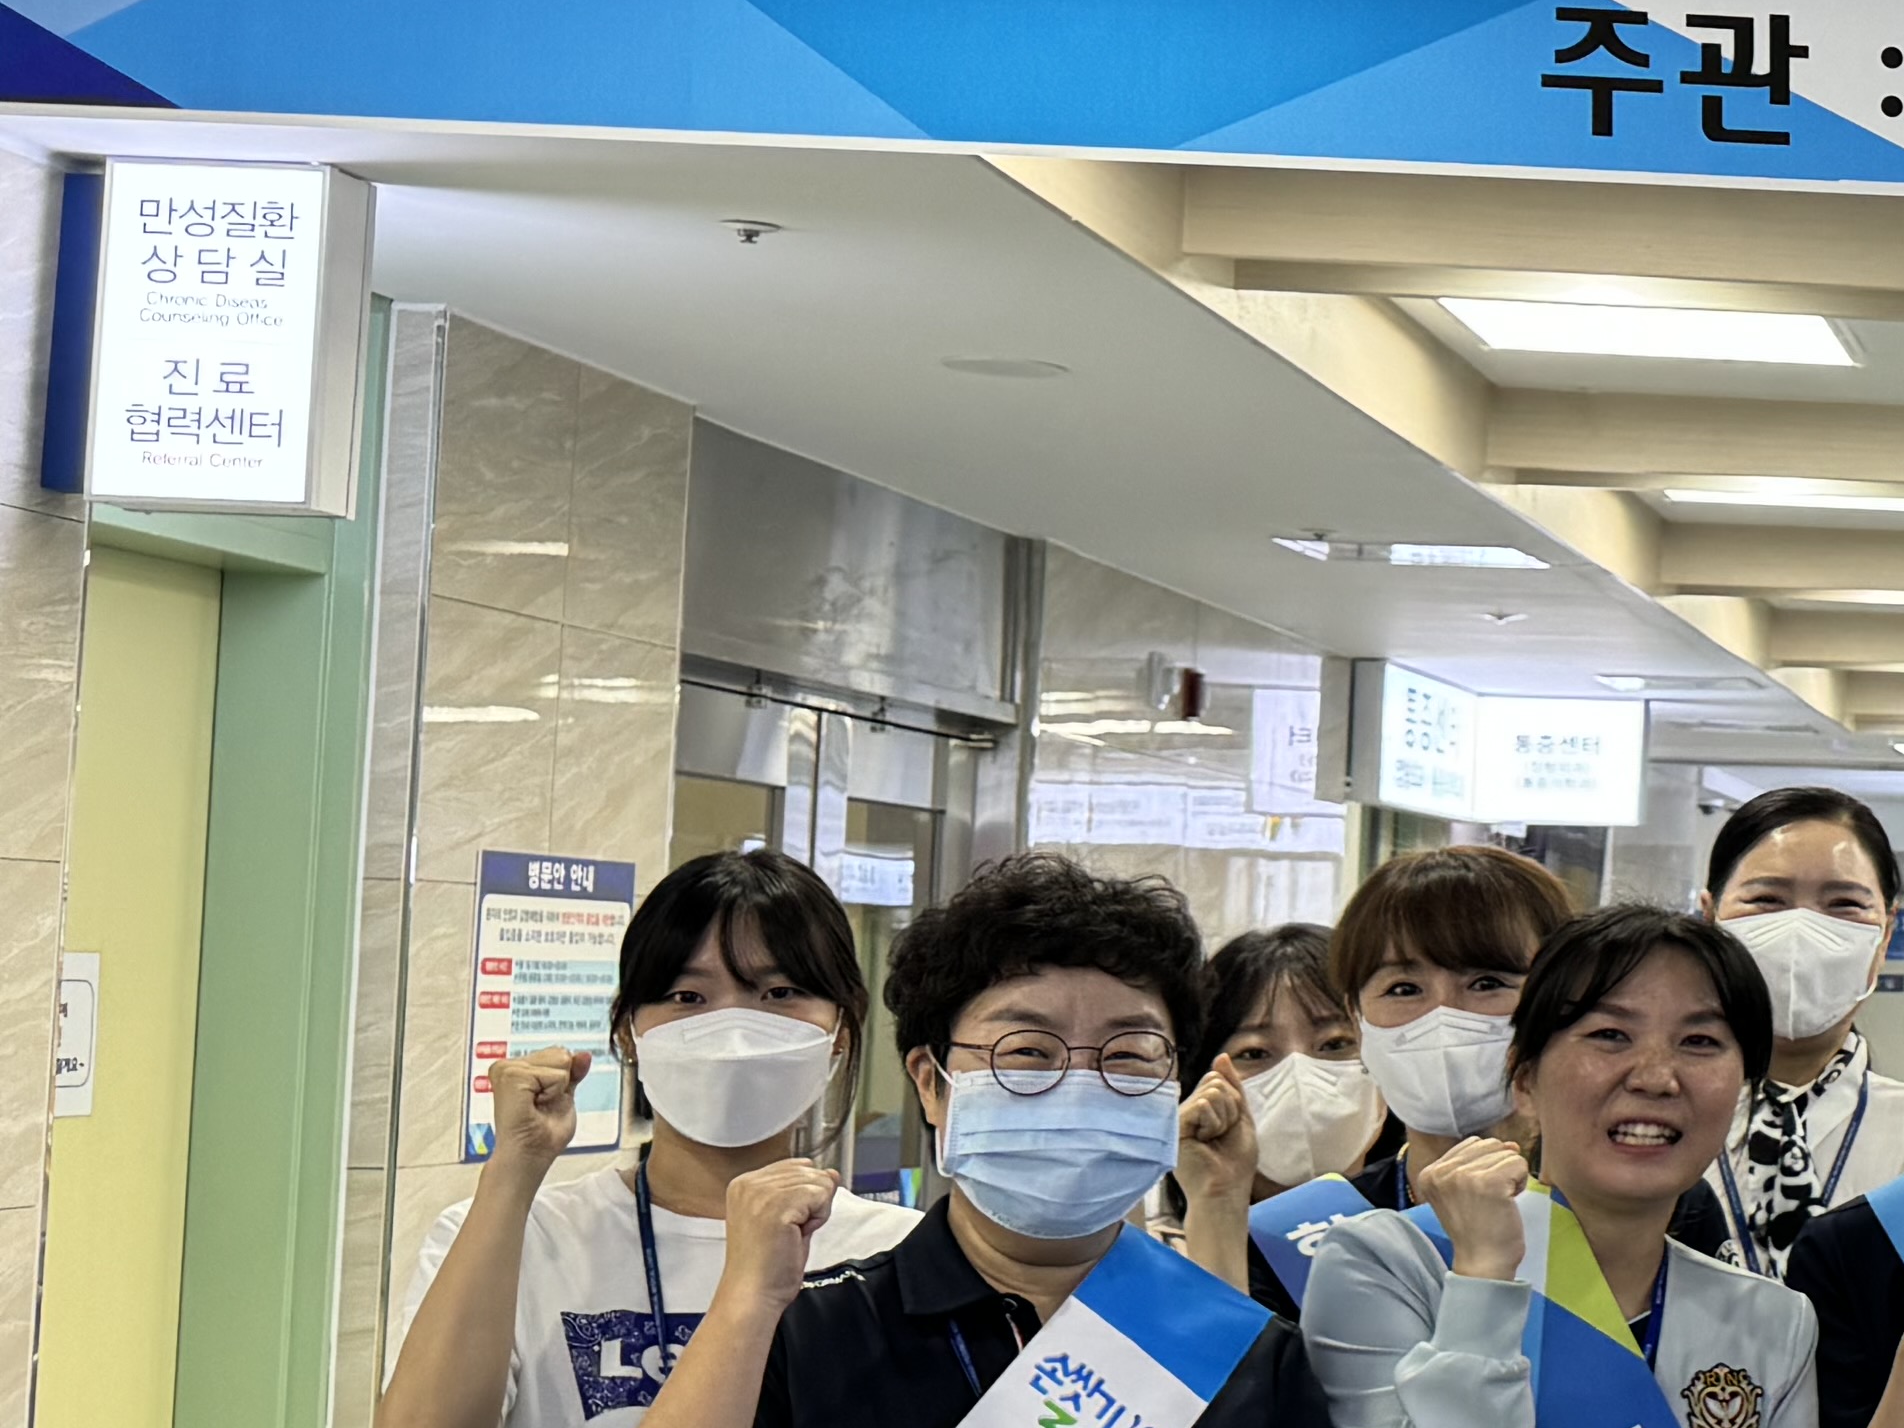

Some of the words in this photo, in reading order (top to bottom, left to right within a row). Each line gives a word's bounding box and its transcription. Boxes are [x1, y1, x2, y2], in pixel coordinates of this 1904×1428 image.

[1541, 7, 1809, 147] 주관
[139, 197, 300, 240] 만성질환
[125, 403, 283, 448] 협력센터
[528, 860, 566, 890] 병문안
[570, 863, 595, 893] 안내
